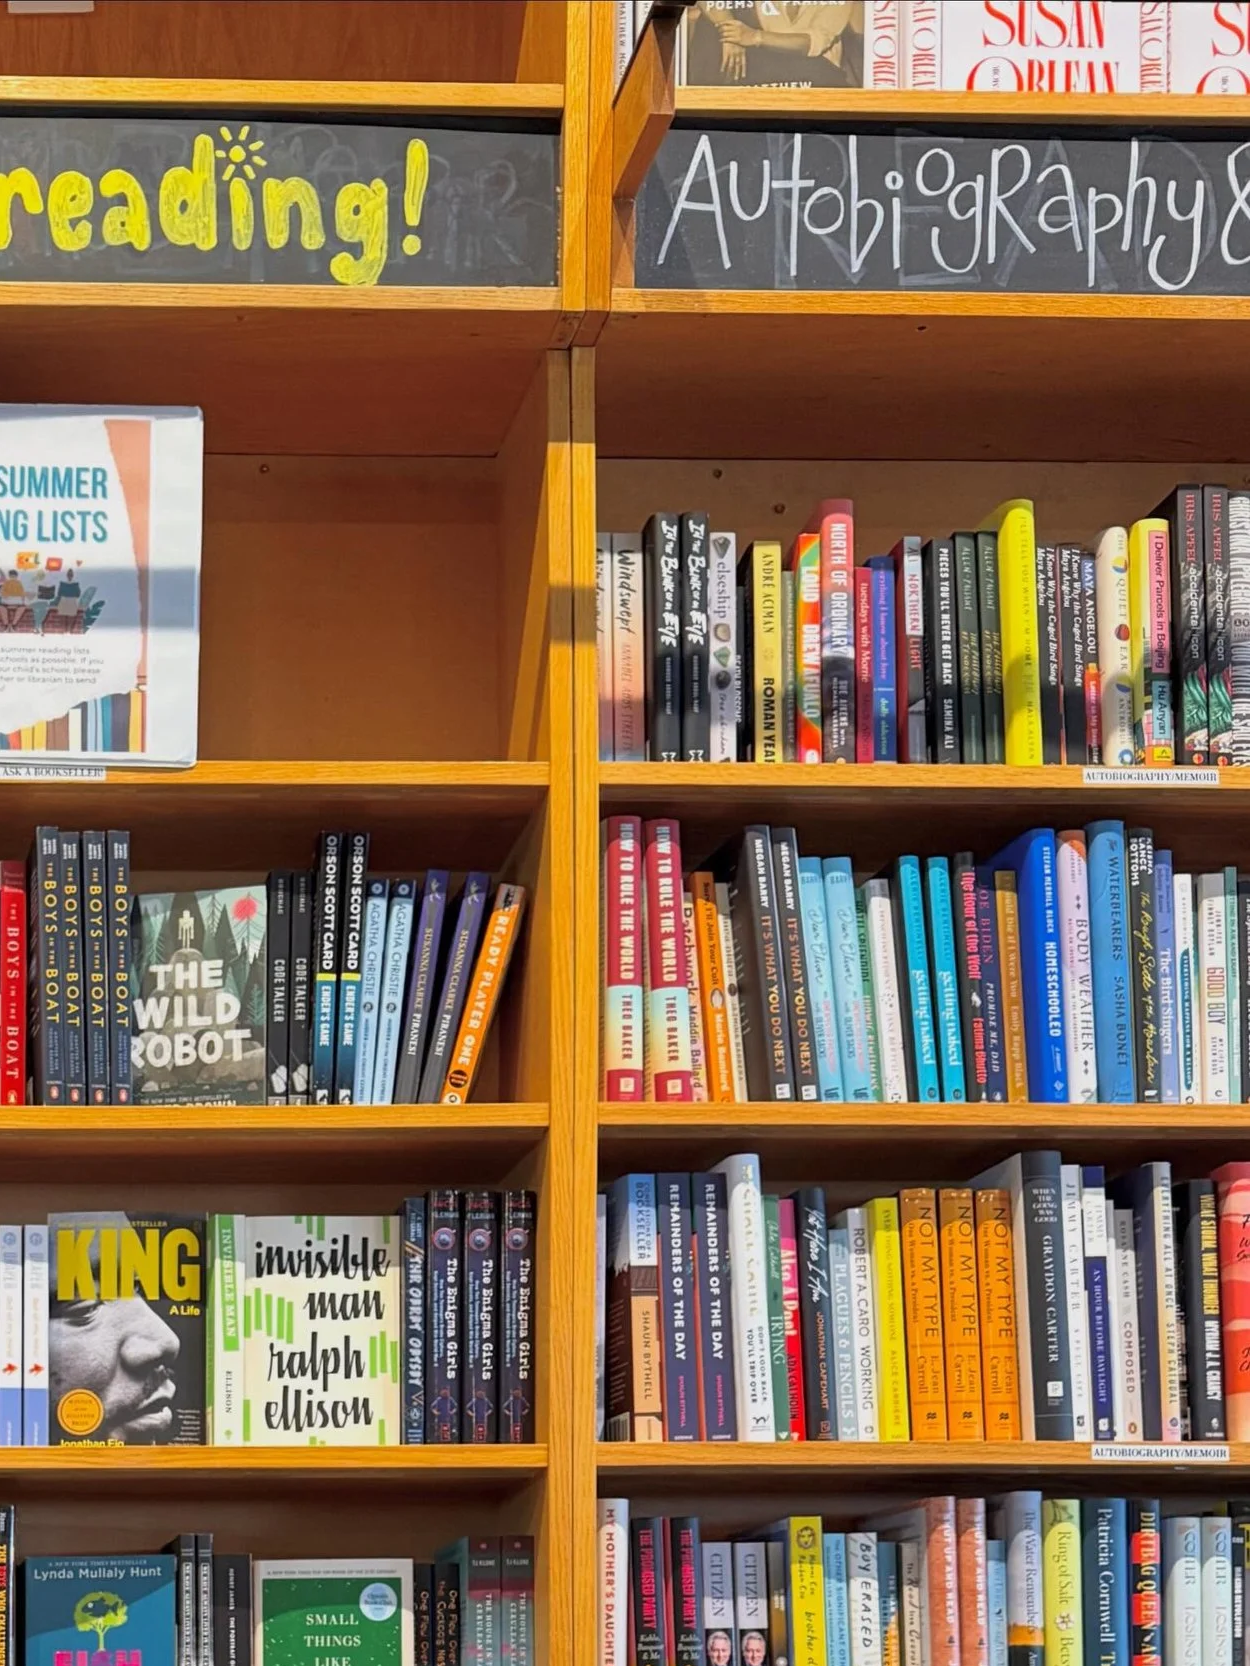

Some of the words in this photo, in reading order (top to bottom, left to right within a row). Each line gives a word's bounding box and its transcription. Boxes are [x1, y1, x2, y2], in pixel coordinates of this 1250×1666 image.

[983, 1, 1106, 50] SUSAN
[37, 510, 109, 543] LISTS
[831, 523, 846, 574] NORTH
[831, 578, 846, 594] OF
[831, 599, 848, 655] ORDINARY
[2, 766, 21, 777] ASK
[25, 767, 32, 777] A
[34, 766, 104, 778] BOOKSELLER!
[1085, 771, 1218, 783] AUTOBIOGRAPHY/MEMOIR
[151, 960, 224, 990] THE
[1046, 942, 1062, 1037] HOMESCHOOLED
[132, 996, 242, 1030] WILD
[130, 1029, 251, 1068] ROBOT
[56, 1227, 199, 1302] KING
[255, 1234, 391, 1280] invisible
[169, 1307, 179, 1316] A
[182, 1306, 201, 1316] Life
[304, 1290, 385, 1321] man
[267, 1332, 364, 1391] ralph
[862, 1346, 874, 1411] WORKING
[264, 1385, 374, 1433] ellison
[1094, 1448, 1228, 1460] AUTOBIOGRAPHY/MEMOIR
[1096, 1507, 1112, 1567] Patricia
[33, 1568, 75, 1581] Lynda
[78, 1566, 126, 1580] Mullaly
[130, 1565, 162, 1577] Hunt
[305, 1613, 359, 1626] SMALL
[1098, 1570, 1113, 1644] Cornwell
[304, 1634, 361, 1648] THINGS
